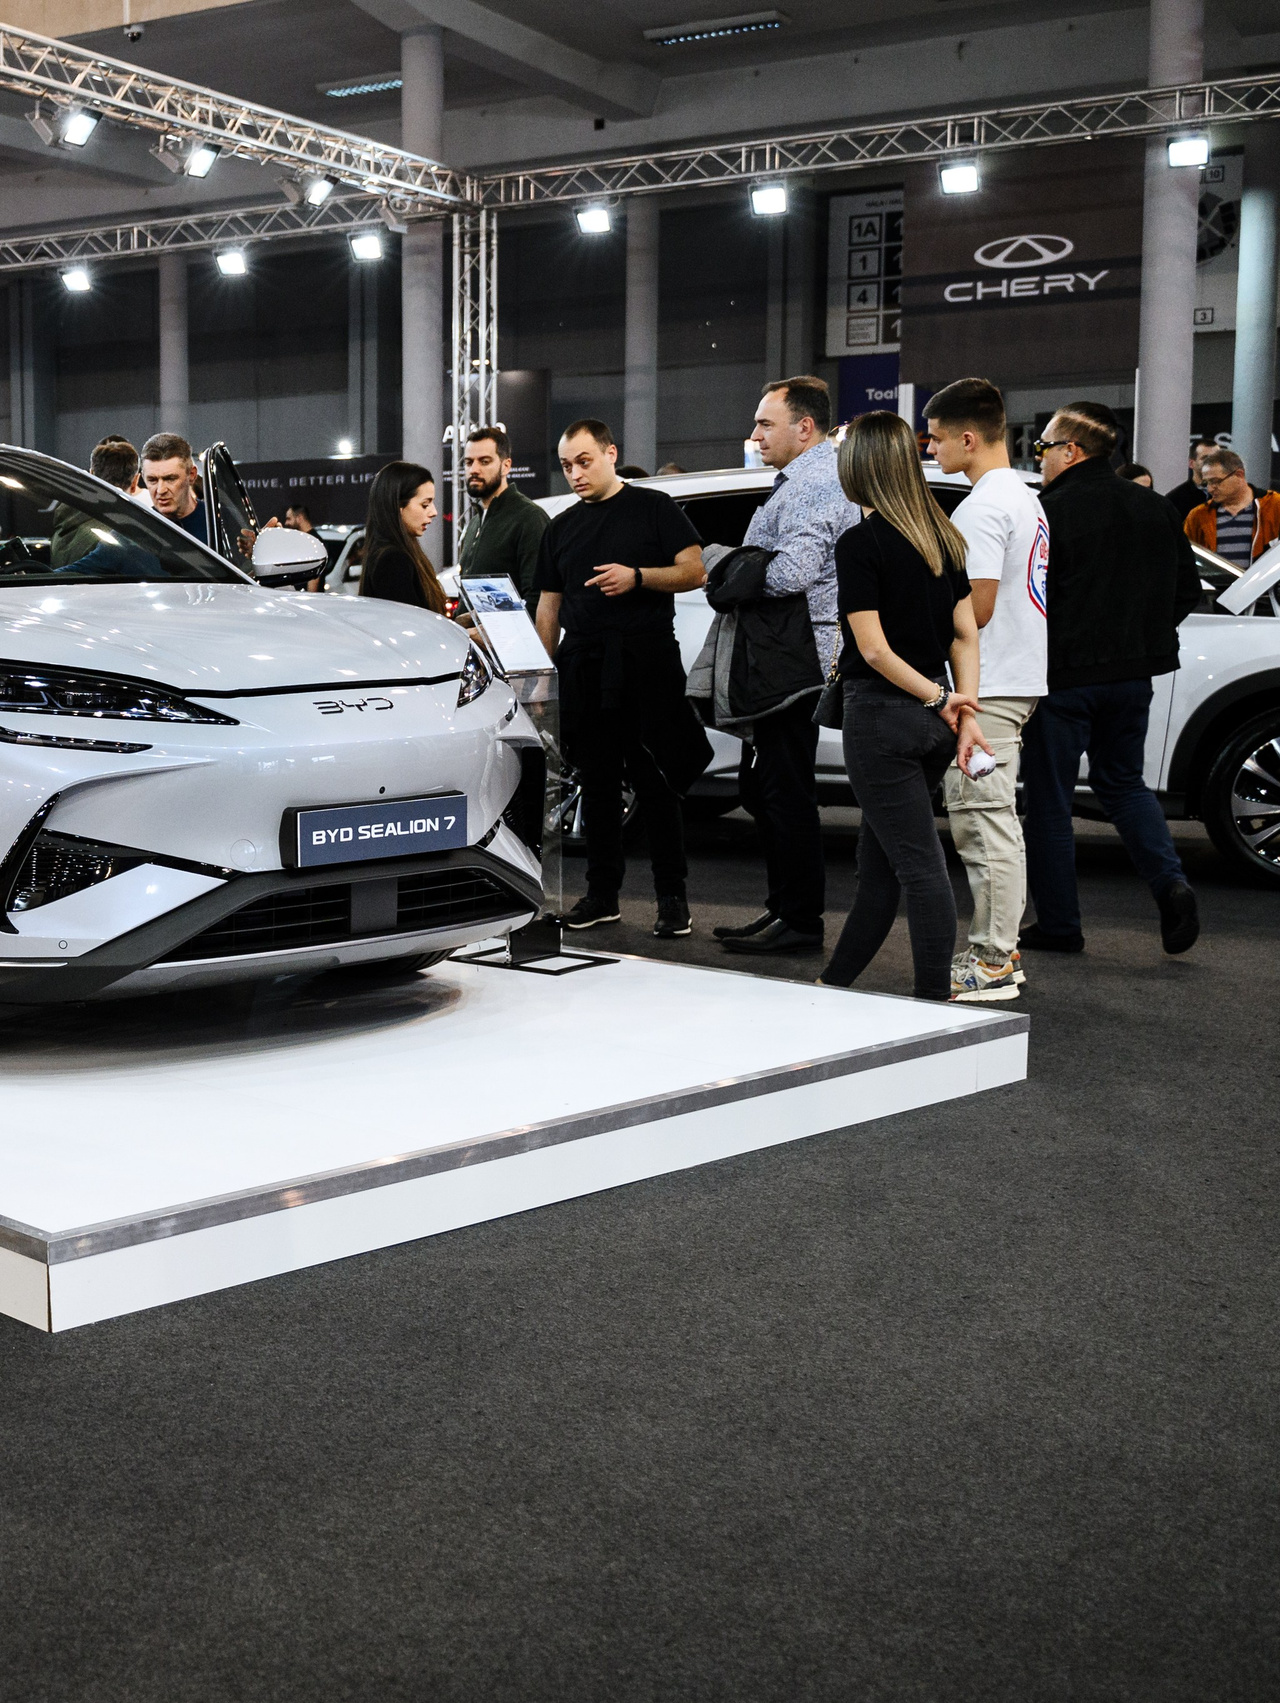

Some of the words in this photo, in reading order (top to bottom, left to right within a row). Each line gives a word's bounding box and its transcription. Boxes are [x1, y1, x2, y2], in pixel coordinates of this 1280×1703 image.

[854, 221, 877, 238] 1A
[859, 254, 867, 271] 1
[943, 269, 1110, 303] CHERY
[856, 288, 868, 305] 4
[1200, 312, 1207, 321] 3
[865, 386, 898, 400] Toal
[289, 474, 345, 487] BETTER
[351, 472, 376, 484] LIF
[313, 697, 394, 714] BYD
[312, 827, 353, 846] BYD
[358, 817, 439, 840] SEALION
[444, 815, 456, 830] 7
